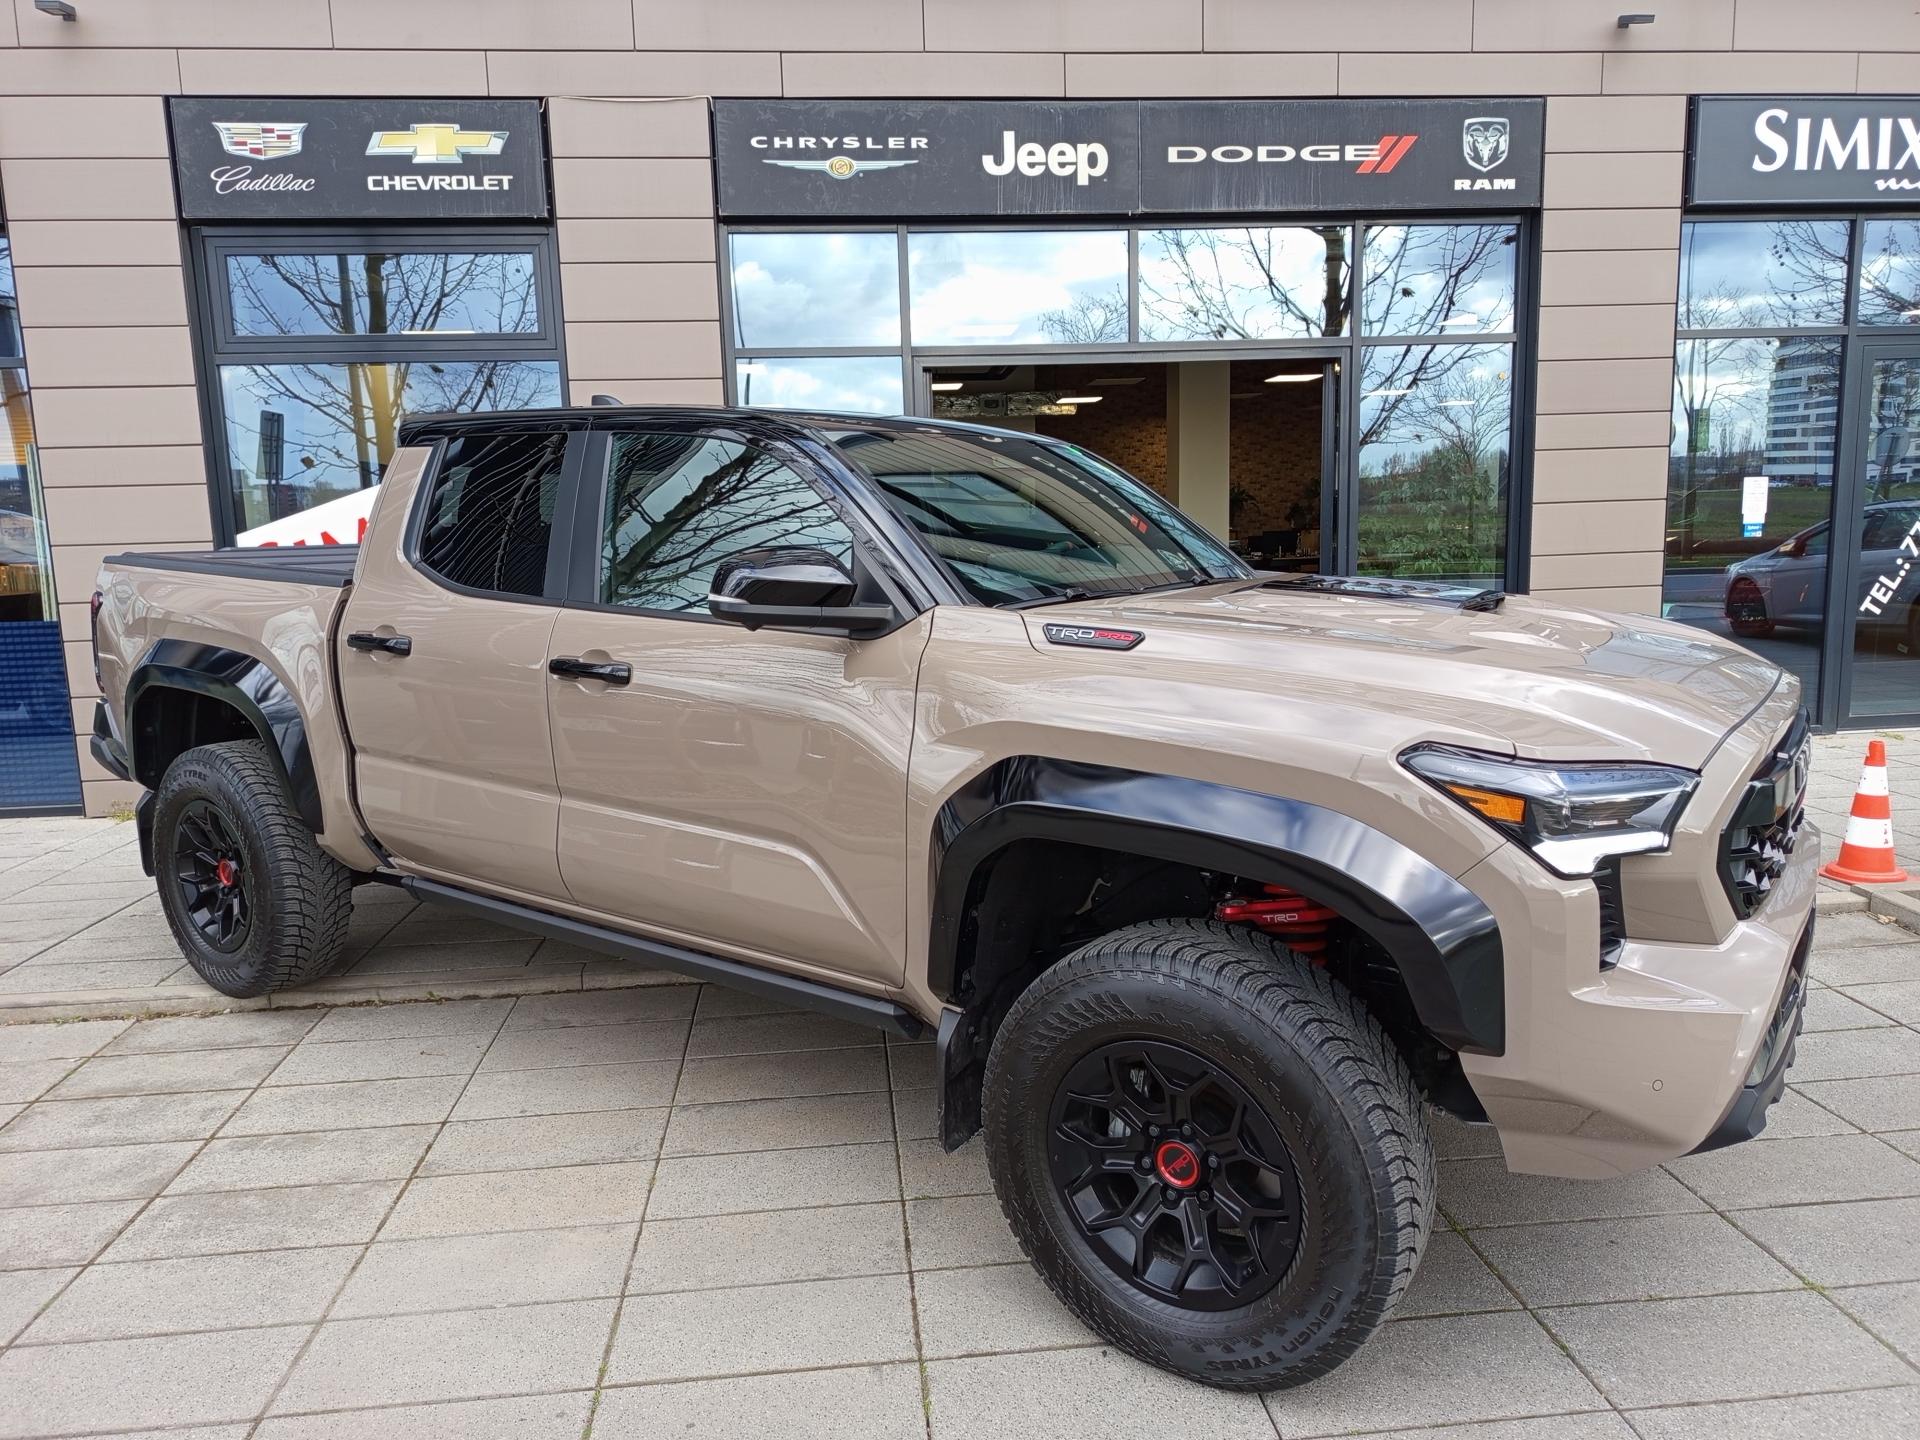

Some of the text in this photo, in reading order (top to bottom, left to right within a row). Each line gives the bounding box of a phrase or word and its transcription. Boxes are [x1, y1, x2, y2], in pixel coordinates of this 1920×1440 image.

[750, 135, 929, 149] CHRYSLER
[982, 130, 1108, 185] Jeep
[1168, 145, 1381, 163] DODGE
[210, 165, 315, 194] Cadillac
[367, 175, 513, 191] CHEVROLET
[1454, 178, 1516, 191] RAM
[1262, 913, 1298, 923] TRD
[1204, 1350, 1282, 1372] TYRES
